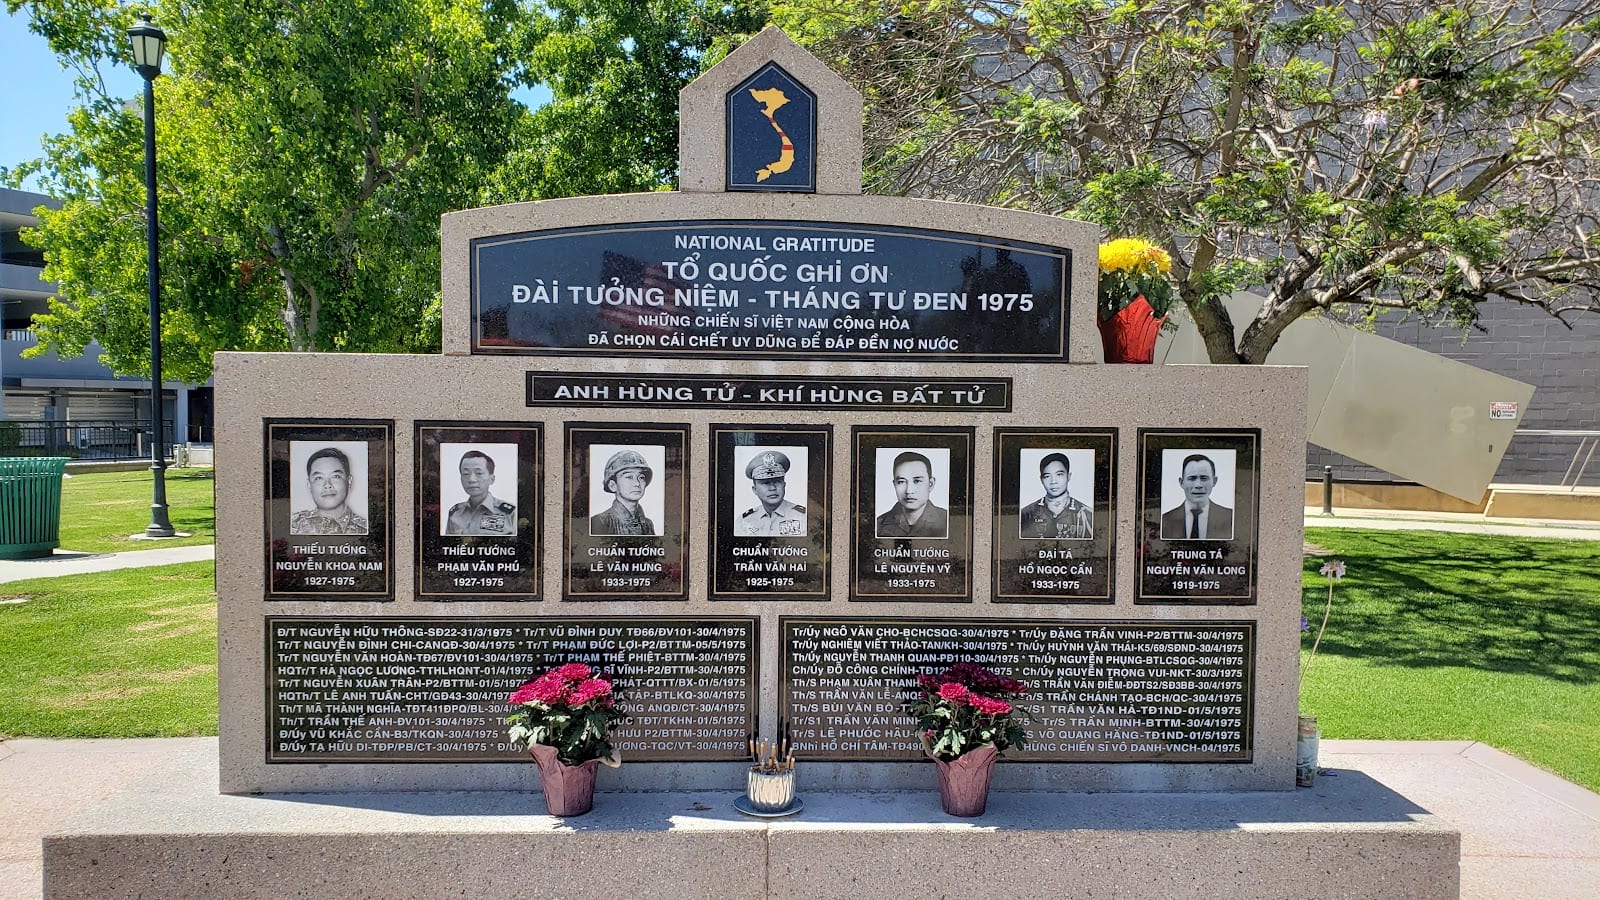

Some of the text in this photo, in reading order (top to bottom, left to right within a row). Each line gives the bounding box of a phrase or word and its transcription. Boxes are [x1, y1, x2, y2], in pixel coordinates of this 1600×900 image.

[675, 232, 875, 253] NATIONAL GRATITUDE
[661, 252, 699, 280] TỔ
[708, 253, 787, 283] QUỐC
[850, 263, 888, 283] ƠN
[764, 282, 860, 309] THÁNG
[868, 289, 906, 310] TƯ
[912, 291, 967, 311] ĐEN
[977, 293, 1034, 312] 1975
[638, 312, 691, 327] NHỮNG
[743, 313, 758, 328] SĨ
[797, 317, 829, 329] NAM
[833, 315, 875, 332] CỘNG
[879, 315, 910, 330] HÒA
[588, 331, 610, 345] ĐÃ
[613, 335, 656, 348] CHỌN
[688, 331, 729, 347] CHẾT
[732, 336, 751, 347] UY
[755, 333, 797, 348] DŨNG
[800, 332, 821, 348] ĐỂ
[824, 334, 855, 349] ĐÁP
[858, 333, 889, 349] ĐỀN
[893, 337, 914, 352] NỢ
[554, 382, 985, 404] ANH HÙNG TỬ KHÍ HÙNG BẤT TỬ
[1492, 410, 1502, 418] NO
[587, 544, 626, 556] CHUẨN
[732, 543, 769, 556] CHUẨN
[874, 545, 911, 558] CHUẨN
[1058, 548, 1073, 559] TÁ
[1170, 548, 1223, 560] TRUNG TÁ
[276, 557, 383, 571] NGUYỄN KHOA NAM
[437, 559, 520, 574] PHẠM VĂN PHÚ
[590, 560, 662, 572] LÊ VĂN HƯNG
[733, 558, 763, 572] TRẦN
[764, 560, 787, 572] VĂN
[874, 561, 951, 573] LÊ NGUYÊN VỸ
[1146, 562, 1246, 575] NGUYỄN VĂN LONG
[1036, 566, 1068, 577] NGỌC
[304, 577, 356, 586] 1927-1975
[453, 578, 504, 586] 1927-1975
[601, 578, 651, 587] 1933-1975
[745, 577, 794, 586] 1925-1975
[887, 579, 936, 588] 1933-1975
[1031, 580, 1080, 589] 1933-1975
[1172, 581, 1220, 590] 1919-1975
[277, 627, 297, 637] Đ/T
[522, 627, 546, 637] Tr/T
[598, 627, 623, 637] DUY
[277, 640, 301, 650] Tr/T
[525, 640, 550, 650] Tr/T
[277, 653, 300, 663] Tr/T
[543, 653, 565, 663] Tr/T
[869, 653, 905, 663] THANH
[278, 666, 317, 676] HQTr/T
